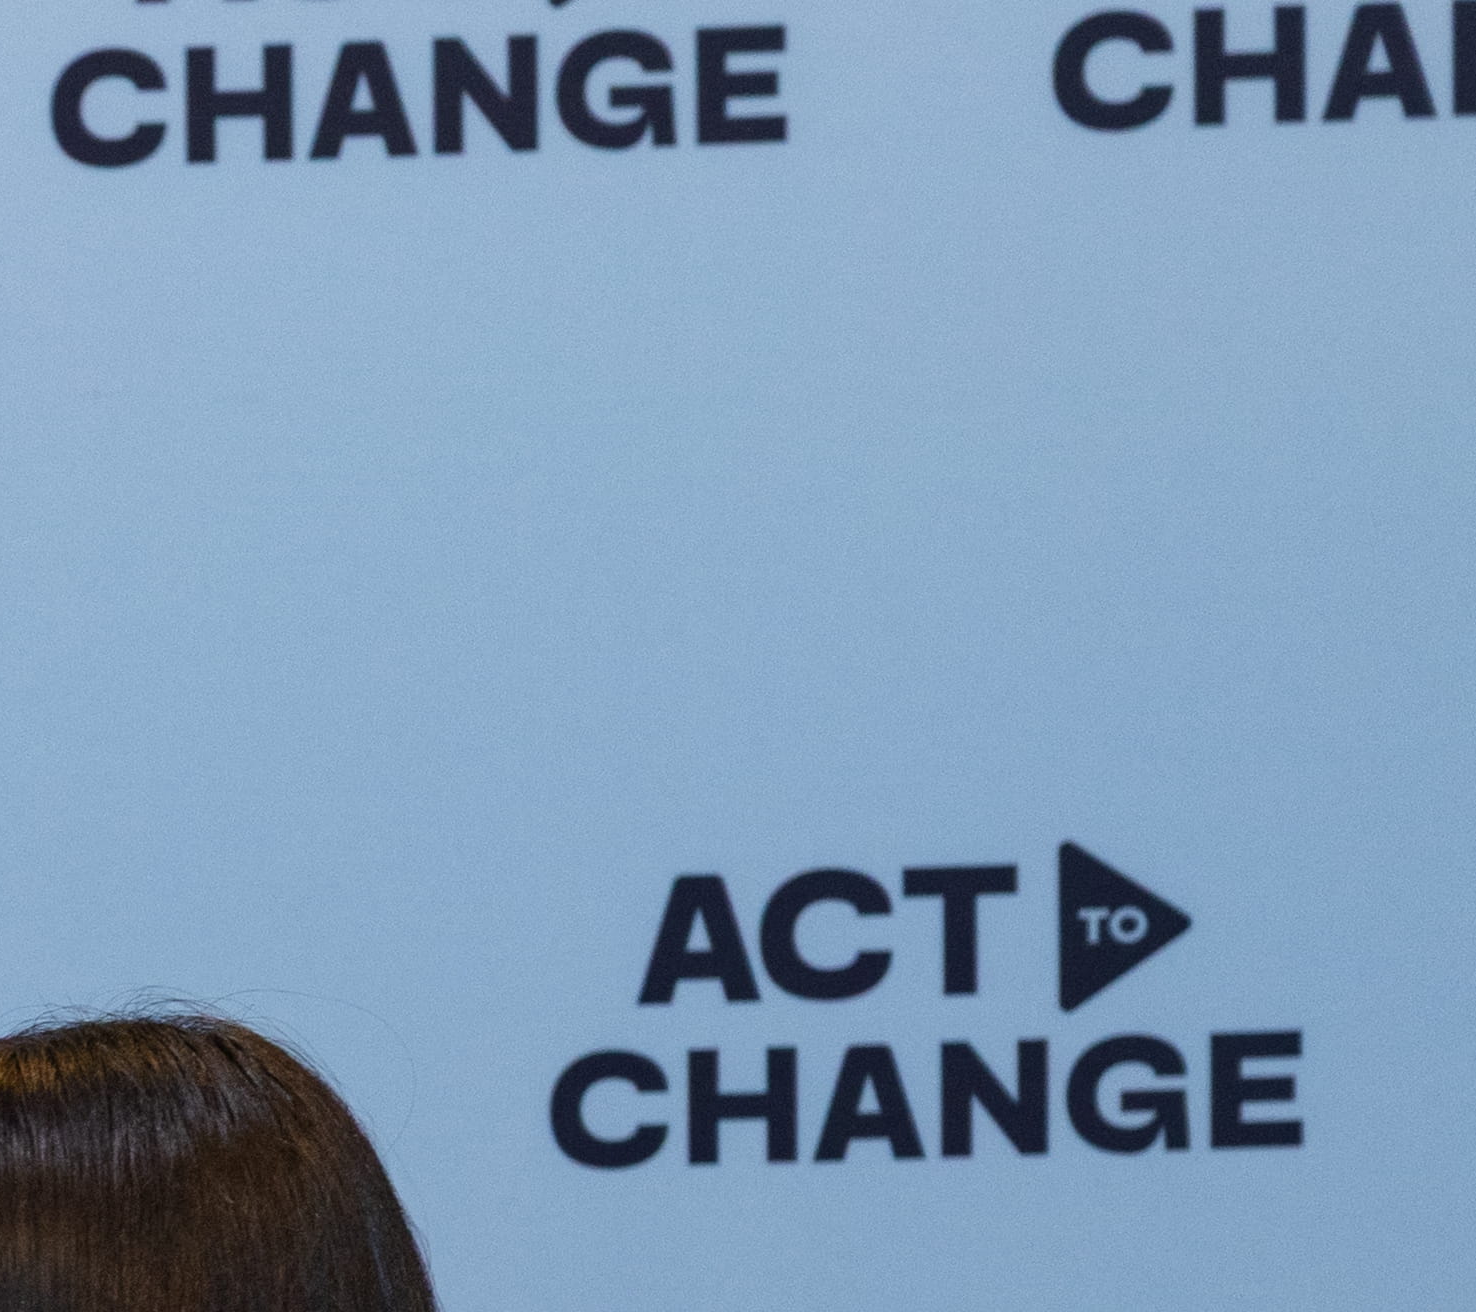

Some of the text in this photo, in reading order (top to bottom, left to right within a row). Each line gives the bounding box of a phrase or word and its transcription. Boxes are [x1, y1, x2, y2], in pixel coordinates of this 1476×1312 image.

[50, 24, 788, 169] CHANGE
[1053, 2, 1476, 132] CHA
[637, 864, 1149, 1006] ACT TO
[549, 1029, 1304, 1171] CHANGE
